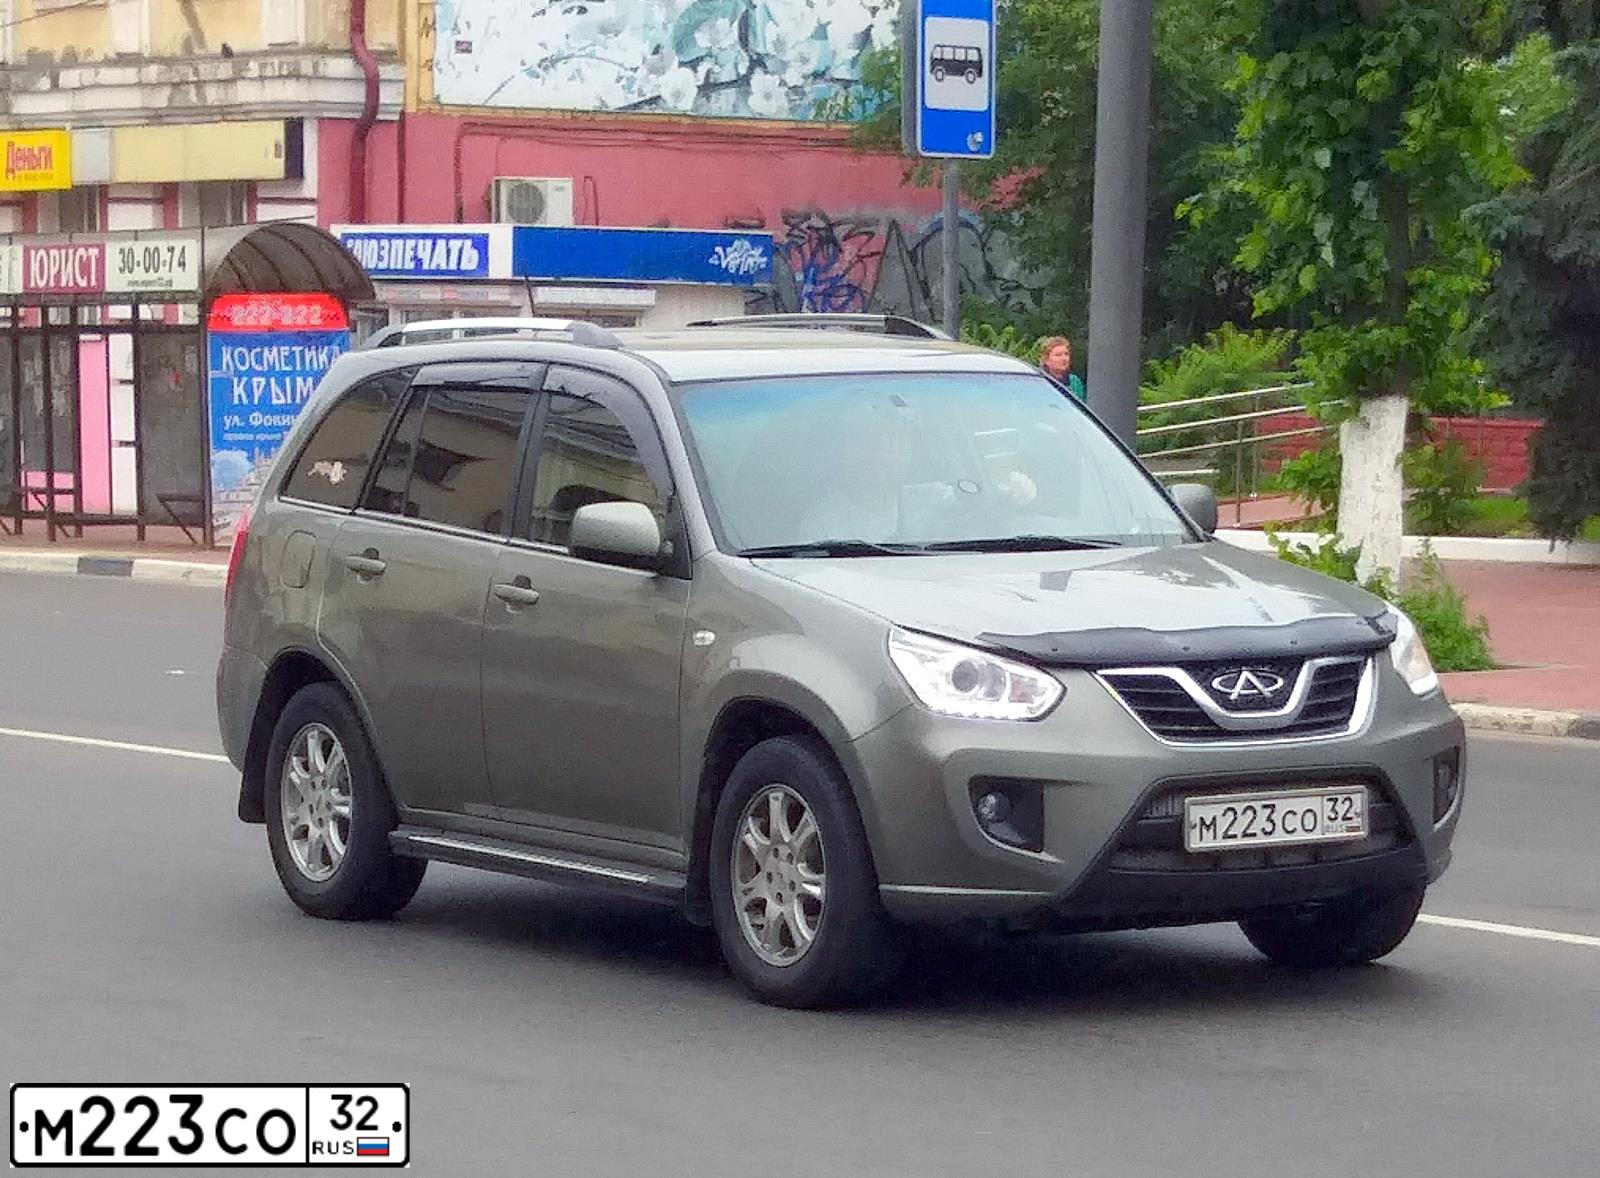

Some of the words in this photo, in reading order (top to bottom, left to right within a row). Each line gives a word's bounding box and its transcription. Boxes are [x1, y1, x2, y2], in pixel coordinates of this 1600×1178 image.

[30, 246, 99, 288] ЮРИСТ
[233, 376, 322, 406] КРЫМ
[223, 415, 246, 431] ул.
[1199, 803, 1318, 842] М223СО
[1326, 796, 1354, 822] 32
